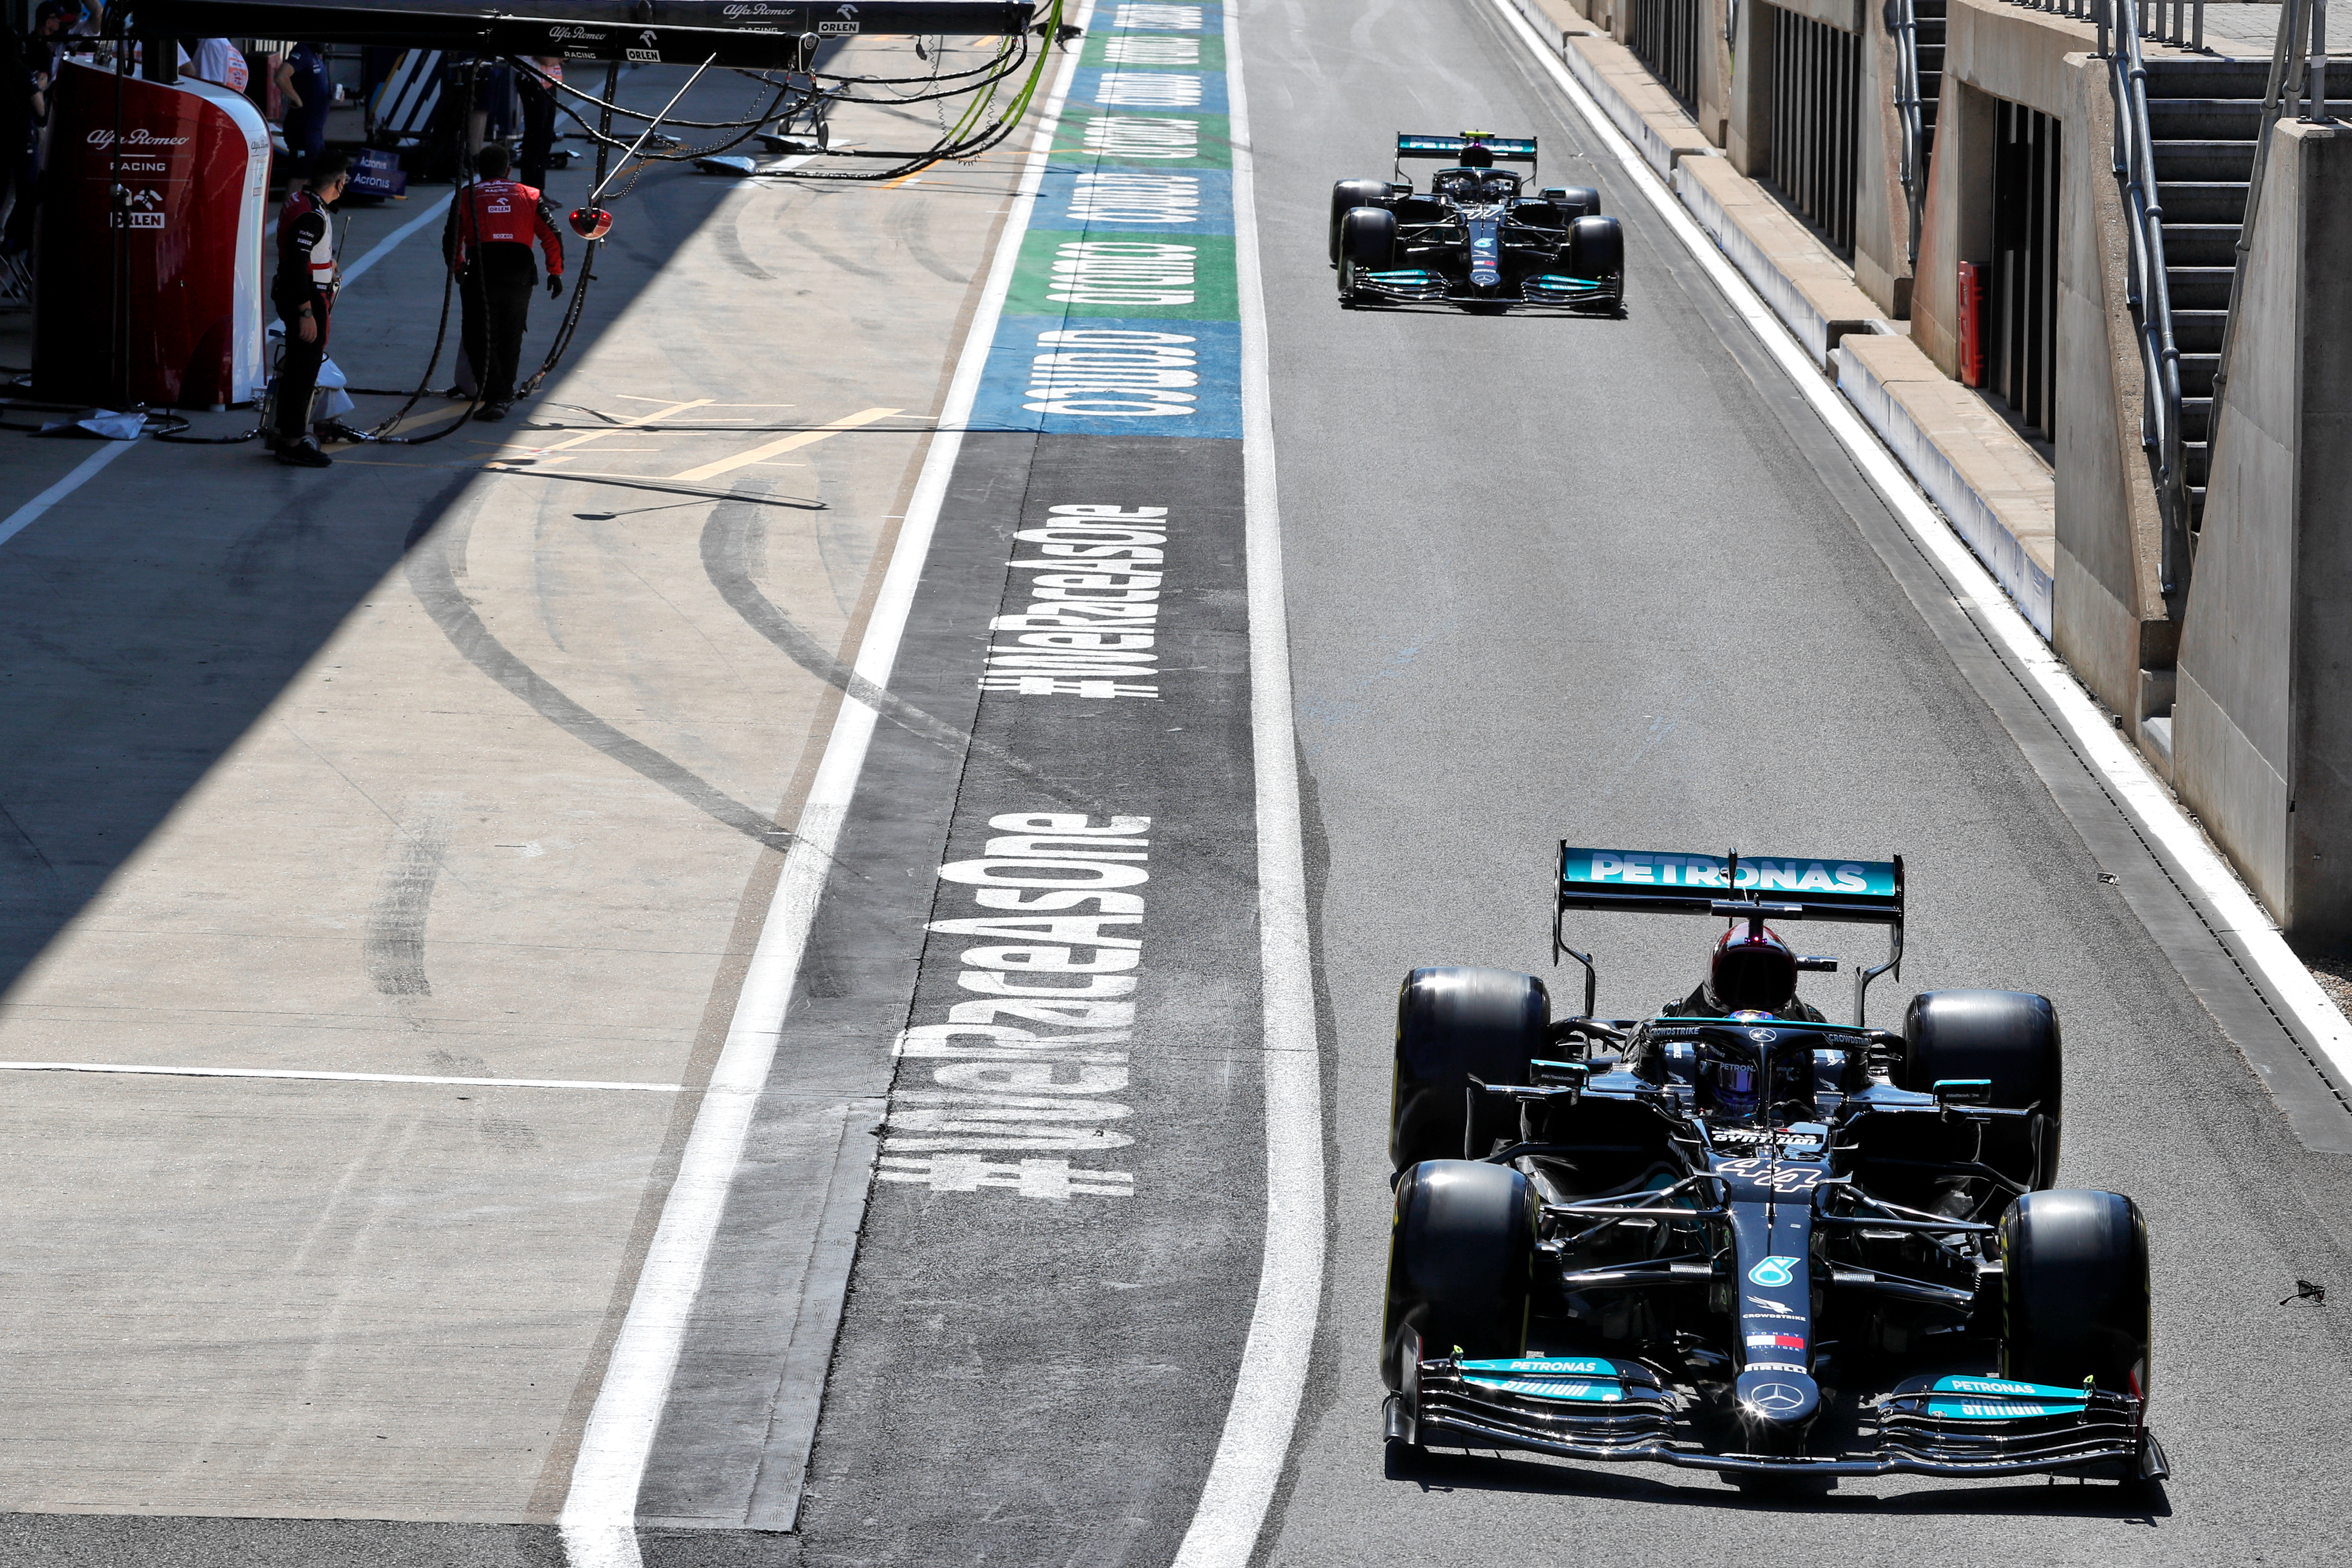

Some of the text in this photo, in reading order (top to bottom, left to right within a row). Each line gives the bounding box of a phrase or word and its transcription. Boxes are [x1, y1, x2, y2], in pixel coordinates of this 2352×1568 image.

[723, 3, 795, 19] Alfa Romeo
[549, 26, 606, 42] Alfa Romeo
[629, 50, 658, 60] ORLEN
[1095, 73, 1201, 107] aramco
[129, 129, 189, 144] Romeo
[1081, 116, 1199, 159] aramco
[1409, 137, 1524, 151] PETRNAS
[360, 156, 386, 170] Acronis
[353, 173, 390, 188] Acronis
[1065, 173, 1200, 223] aramco
[1045, 242, 1197, 305] aramco
[1021, 330, 1198, 416] aramco
[978, 504, 1168, 698] #WeRaceAsOne
[1591, 853, 1867, 893] PETRONAS
[870, 812, 1151, 1198] #WeRaceAsOne
[1651, 1027, 1700, 1035] CROWDSTRIKE
[1716, 1158, 1822, 1193] 44
[1743, 1314, 1806, 1322] CROWDSTRIKE
[1510, 1361, 1596, 1372] PETRONAS
[1744, 1362, 1807, 1375] PIRELLI
[1951, 1380, 2035, 1394] PETRONAS
[1960, 1399, 2044, 1415] SYNTIUM
